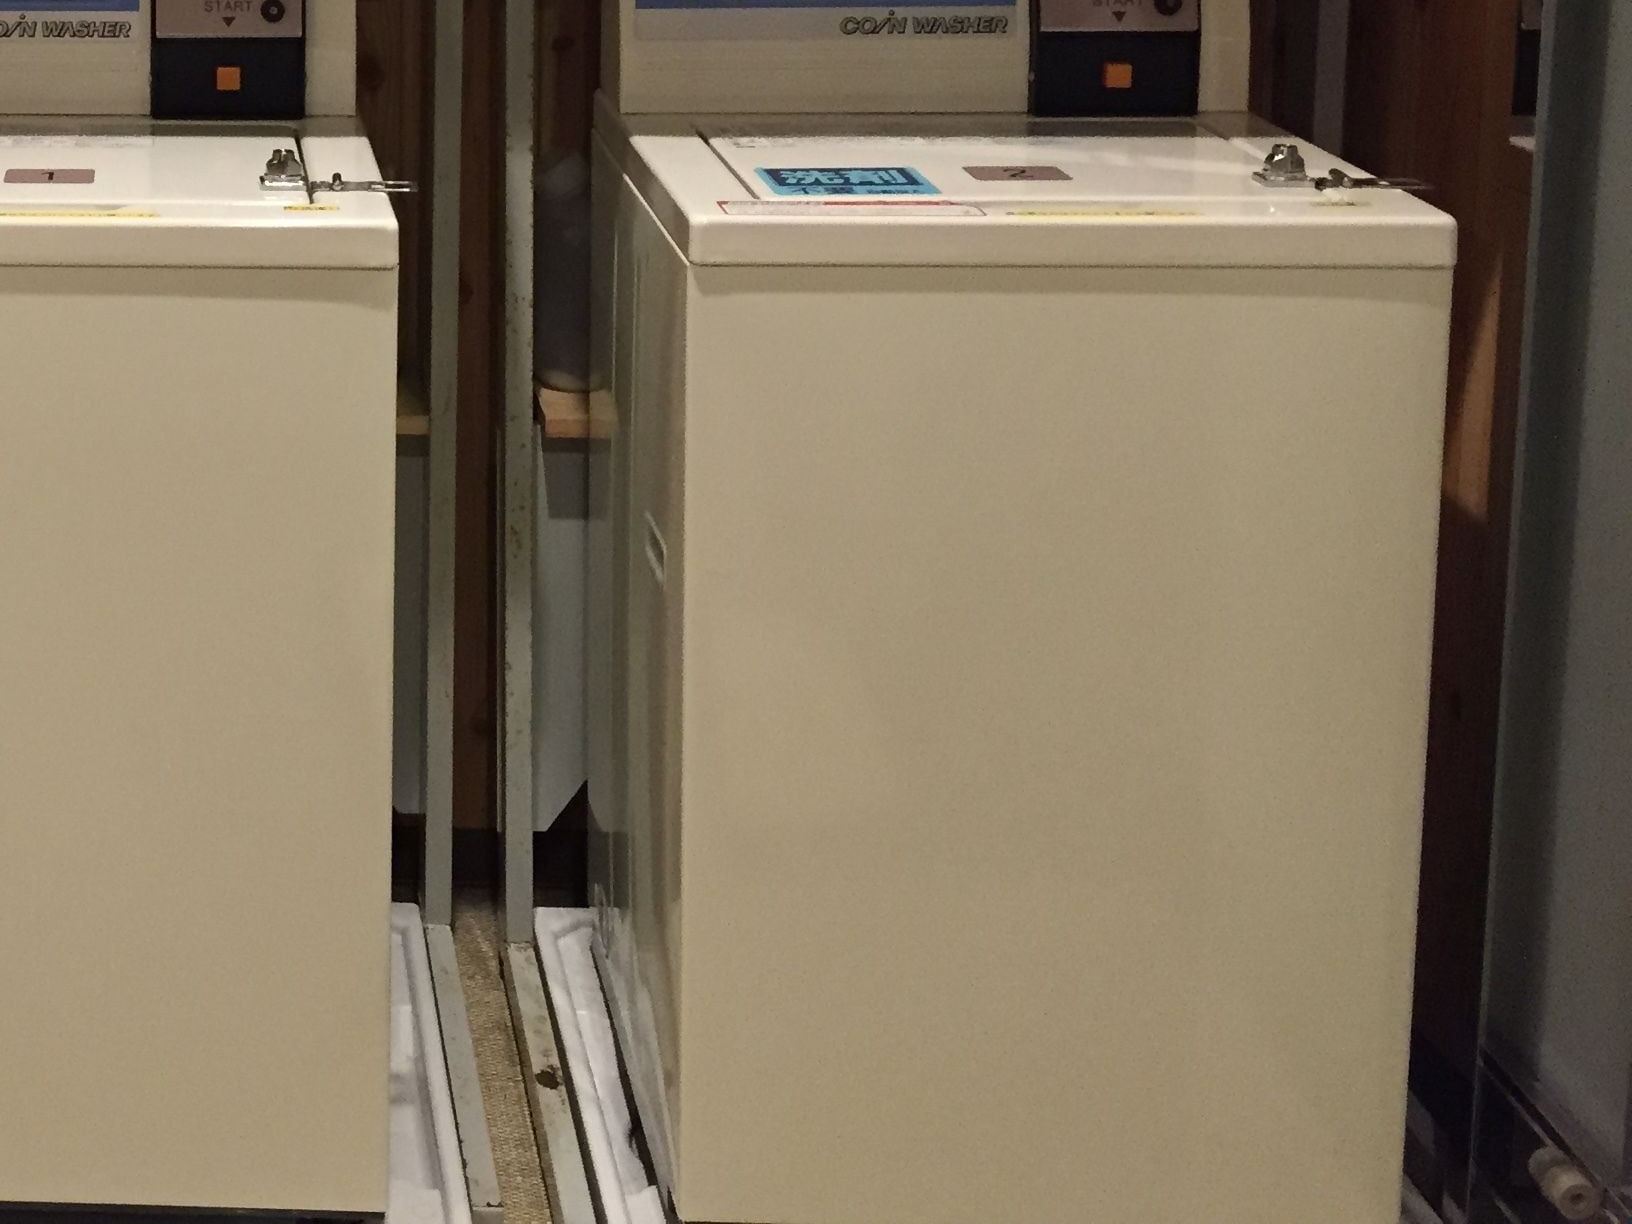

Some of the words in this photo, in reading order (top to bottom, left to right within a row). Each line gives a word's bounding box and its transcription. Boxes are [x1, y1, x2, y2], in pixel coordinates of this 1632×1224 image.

[204, 0, 253, 13] START
[41, 20, 132, 39] WASHER
[839, 10, 908, 36] COIN
[912, 16, 1009, 35] WASHER
[779, 170, 908, 185] 洗剤
[1002, 168, 1034, 178] 2
